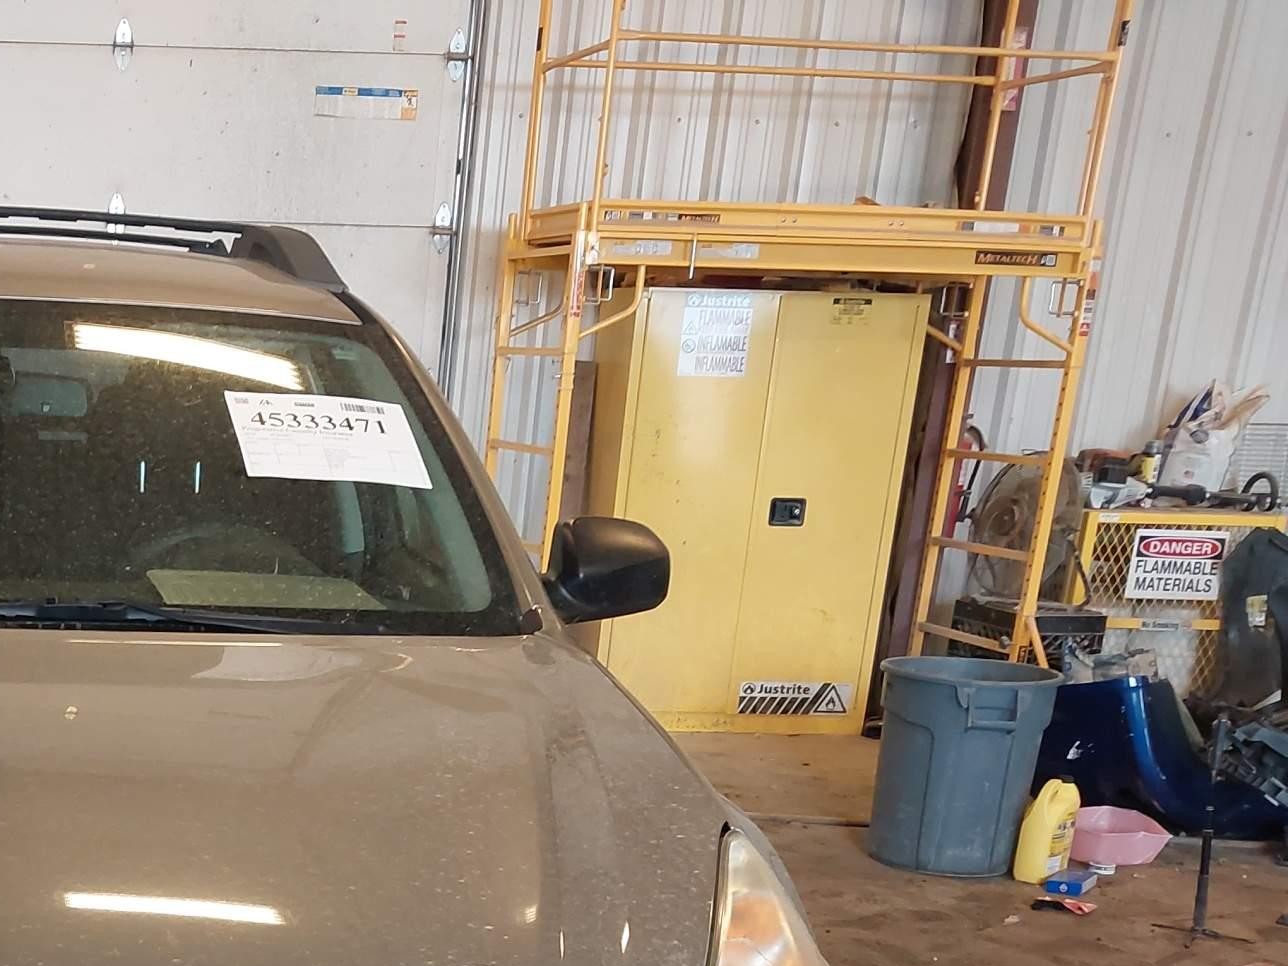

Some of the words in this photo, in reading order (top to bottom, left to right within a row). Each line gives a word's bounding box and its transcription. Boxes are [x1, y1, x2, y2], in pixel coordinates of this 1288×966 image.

[702, 295, 751, 307] Justrite
[699, 309, 752, 326] FLAMMABLE
[697, 336, 747, 352] INFLAMABLE
[694, 356, 745, 373] INFLAMMABLE
[251, 411, 386, 434] 45333471
[1149, 541, 1213, 555] DANGER
[1135, 559, 1219, 576] FLAMMABLE
[1133, 577, 1212, 593] MATERIALS
[757, 683, 810, 695] Justrite
